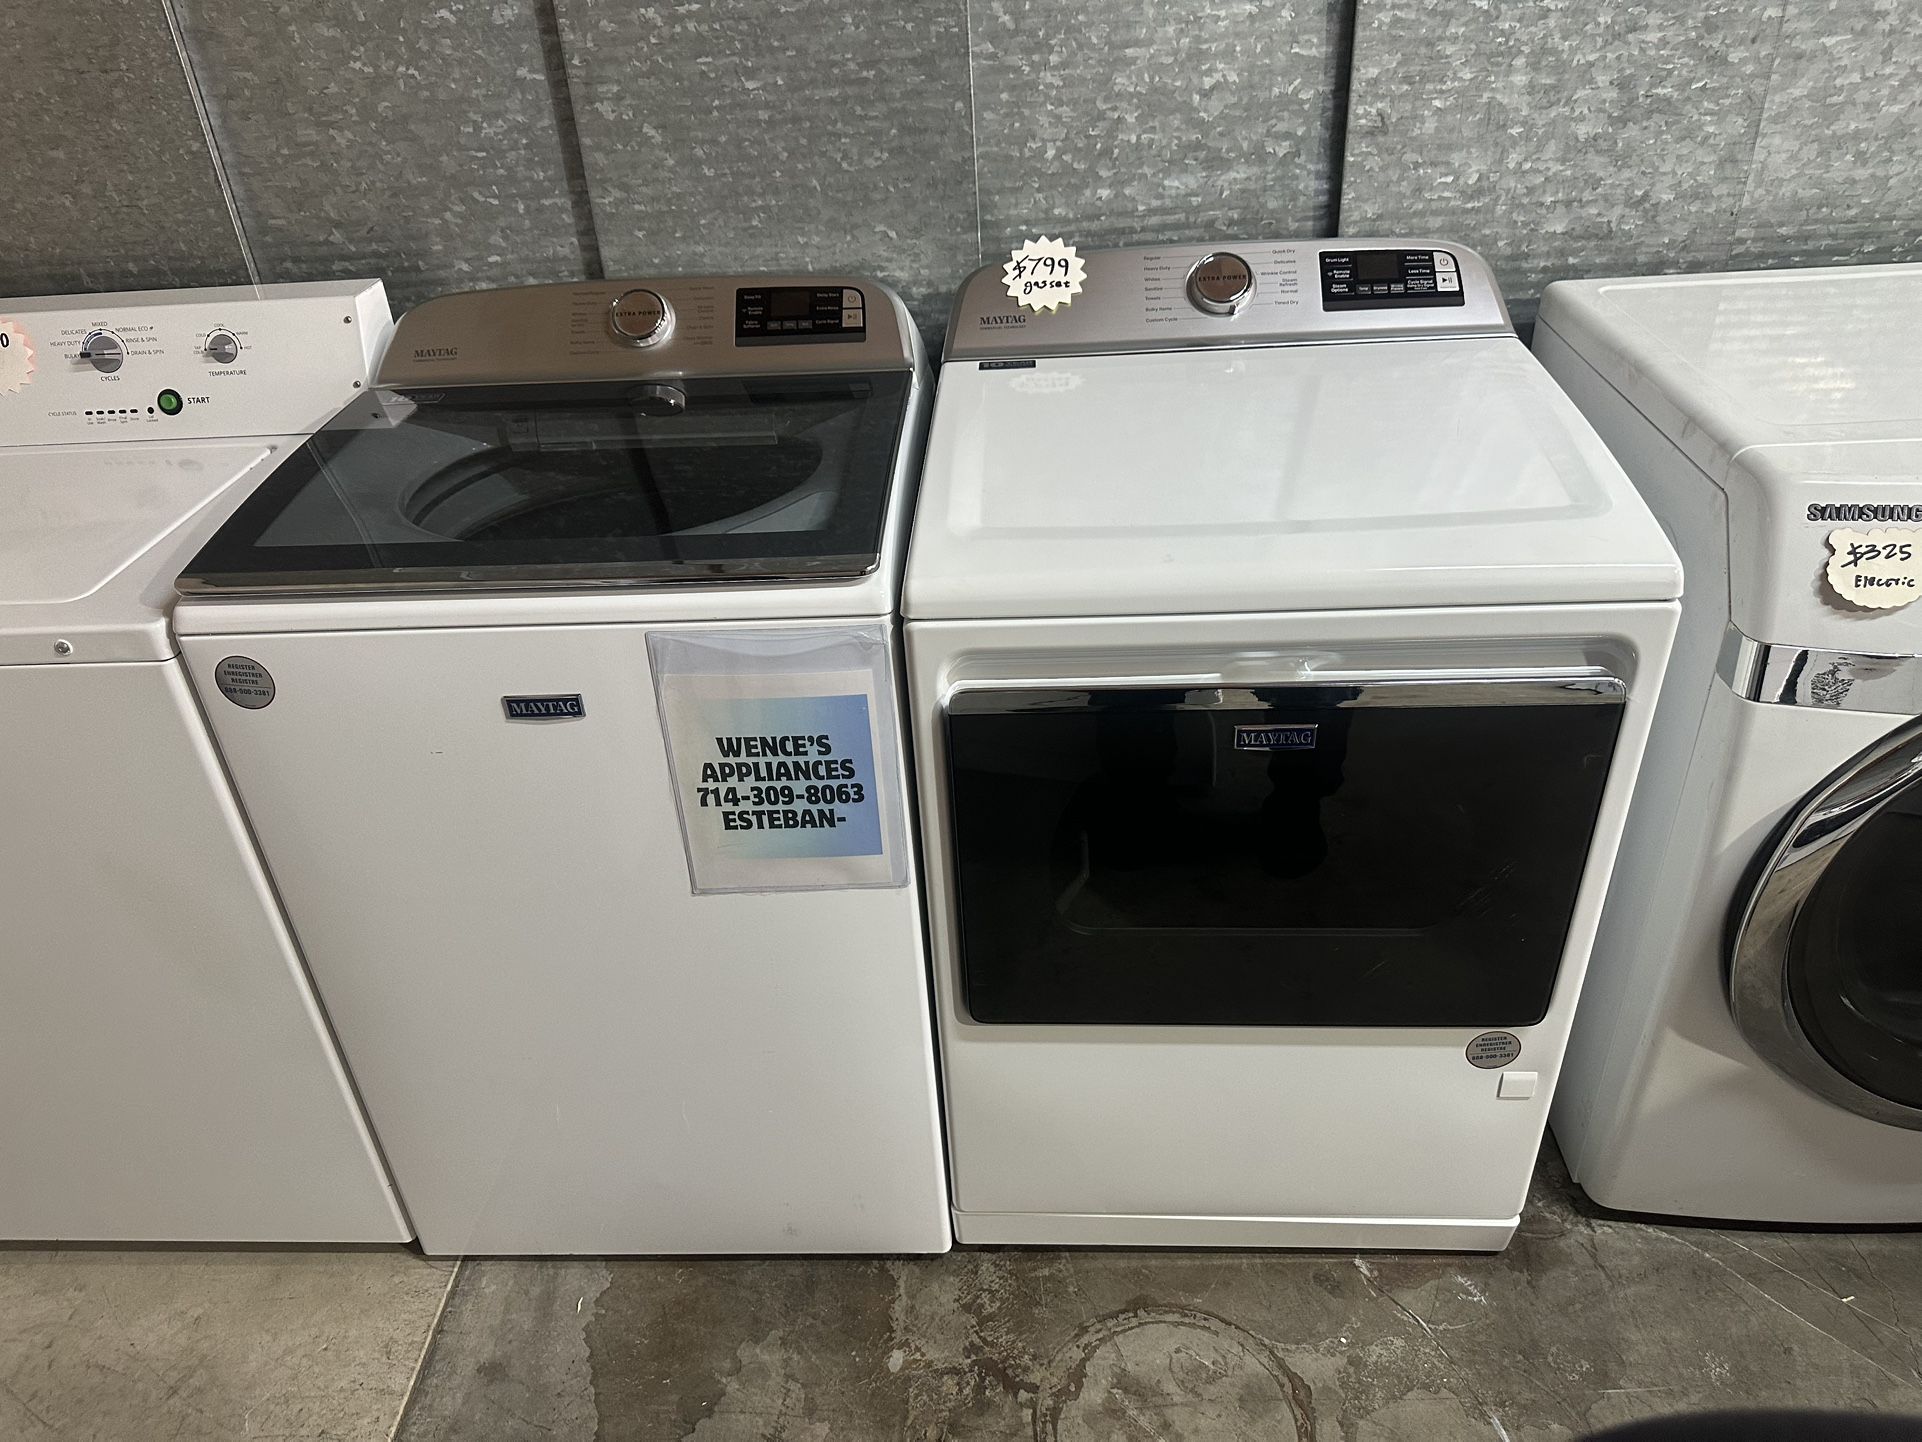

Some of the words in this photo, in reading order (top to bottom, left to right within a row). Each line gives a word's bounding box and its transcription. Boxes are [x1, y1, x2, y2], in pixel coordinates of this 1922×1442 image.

[1012, 254, 1070, 281] $799
[980, 315, 1026, 326] MAYTAG
[414, 347, 458, 358] MAYTAG
[187, 396, 210, 404] START
[1807, 503, 1922, 522] SAMSUNG
[1840, 543, 1912, 568] $325
[224, 670, 263, 679] ENREGISTRER
[227, 663, 256, 671] REGISTER
[510, 701, 579, 714] MAYTAG
[715, 734, 832, 758] WENCE'S
[1240, 731, 1312, 745] MAYTAG
[701, 759, 856, 783] APPLIANCES
[696, 783, 865, 808] 714-309-8063
[722, 808, 847, 831] ESTEBAN-
